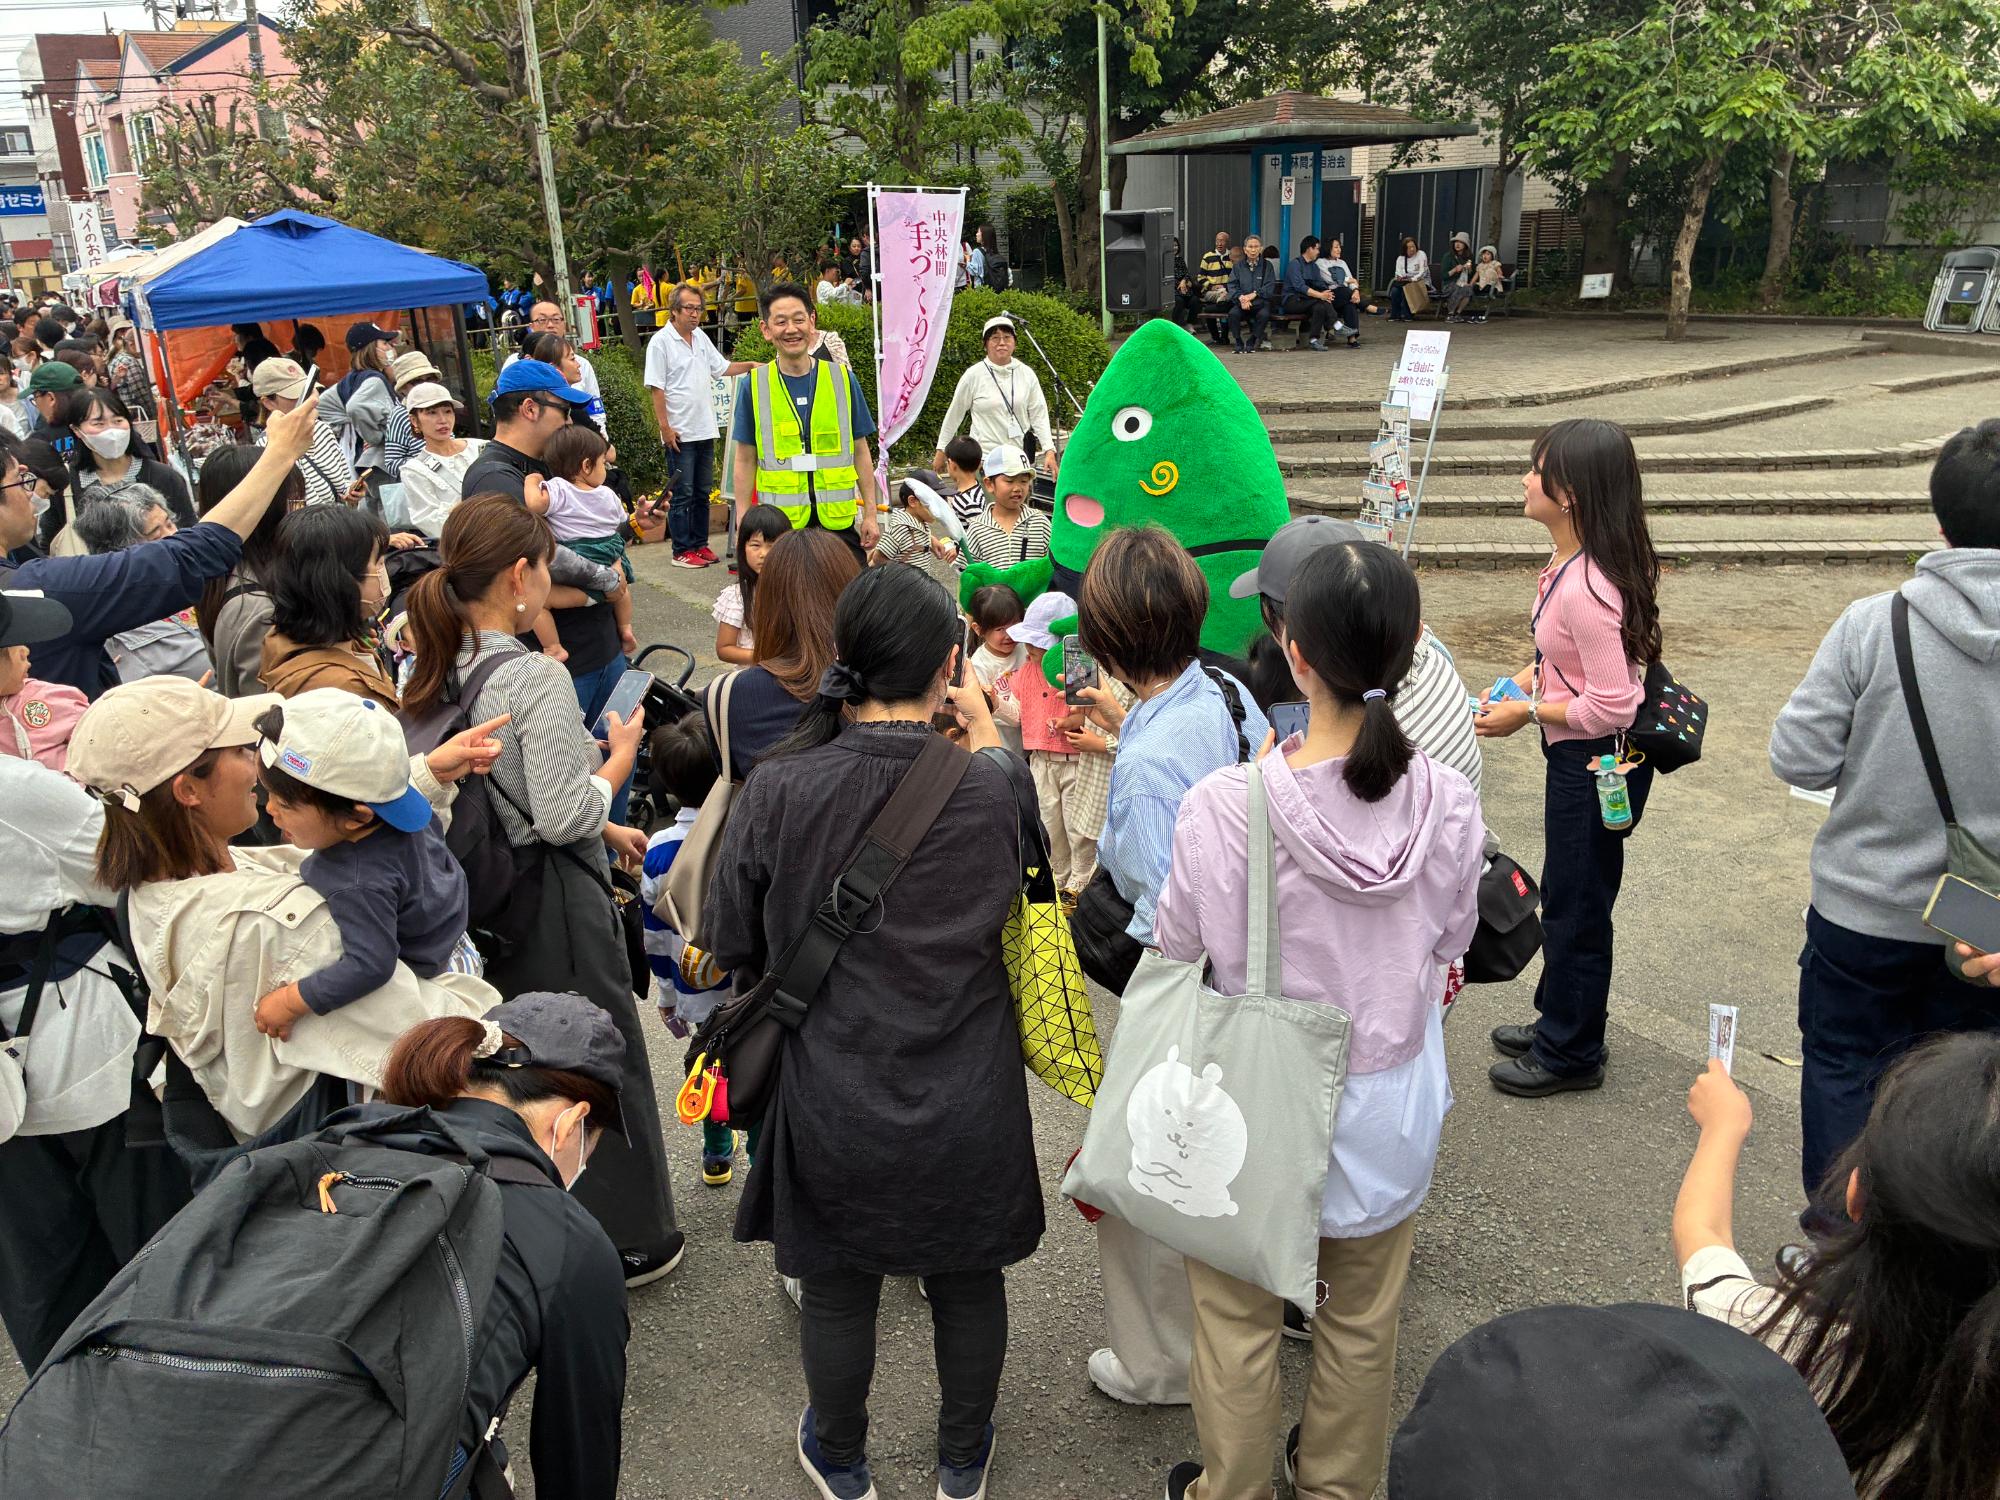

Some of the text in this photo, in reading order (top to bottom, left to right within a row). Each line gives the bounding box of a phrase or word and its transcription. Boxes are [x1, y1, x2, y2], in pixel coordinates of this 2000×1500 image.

[1271, 155, 1345, 169] 中林間自治会
[933, 210, 947, 277] 中央林間
